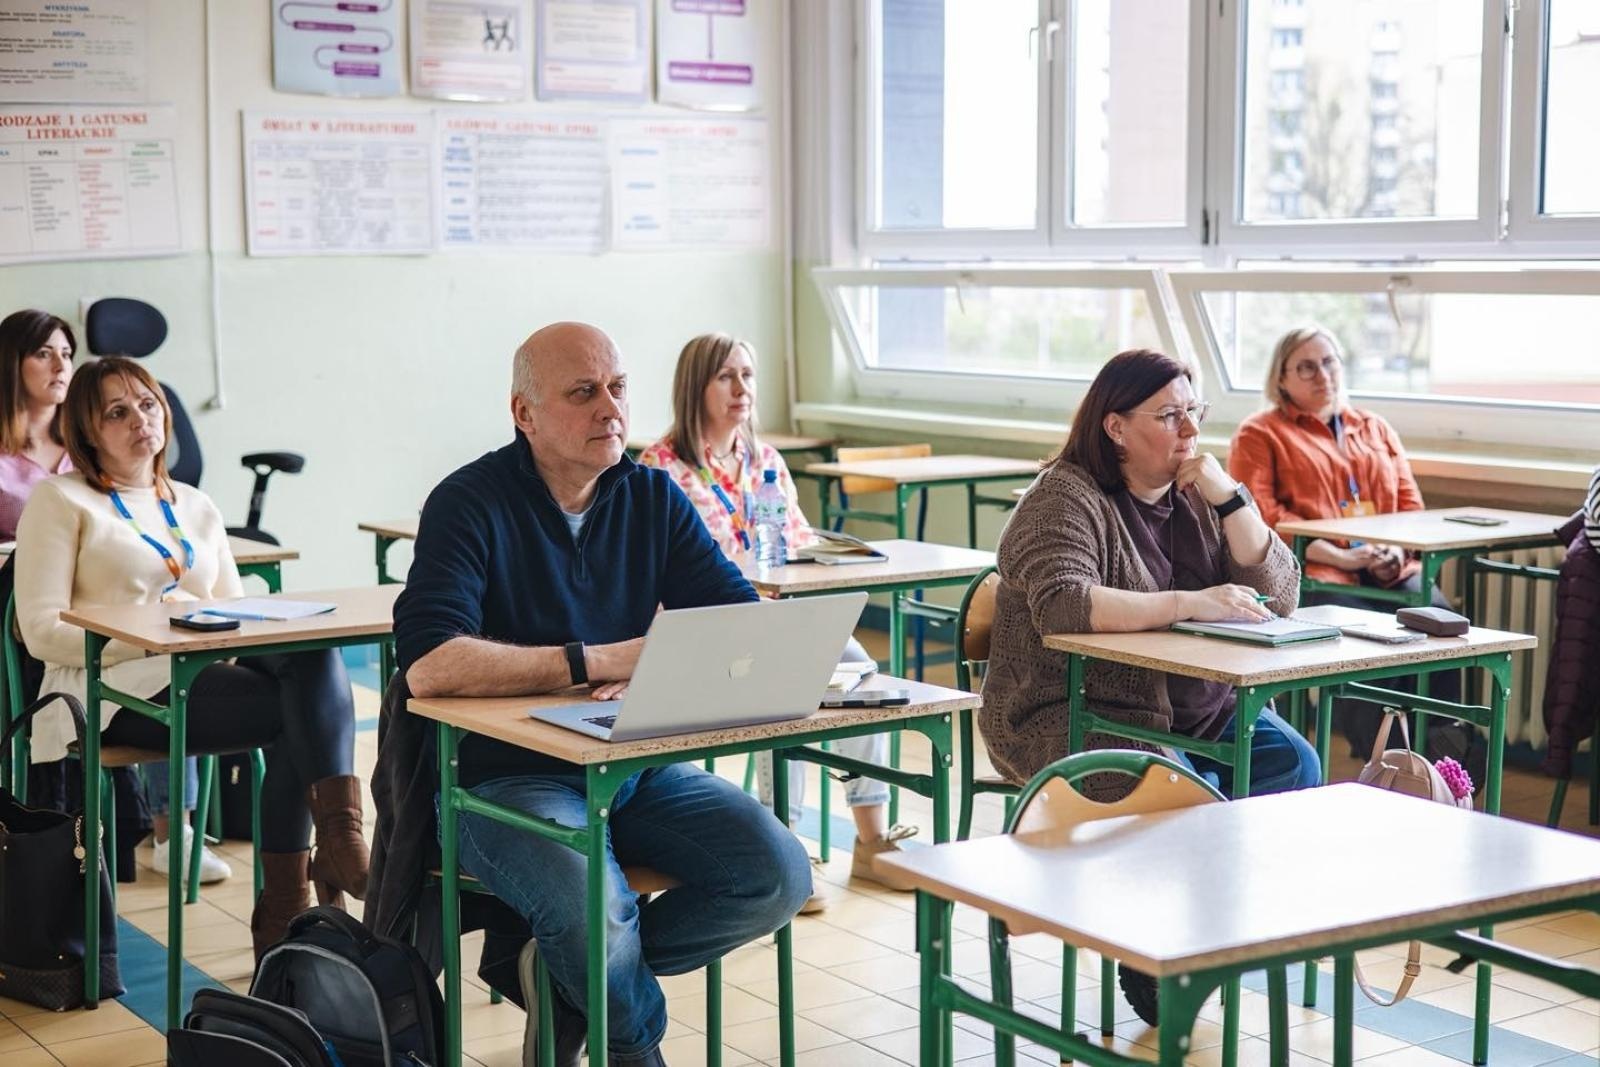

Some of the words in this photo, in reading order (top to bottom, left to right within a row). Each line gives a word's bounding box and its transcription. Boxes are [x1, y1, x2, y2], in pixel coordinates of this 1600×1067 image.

[69, 115, 75, 125] I
[82, 112, 148, 125] GATUNKI
[27, 128, 118, 140] LITERACKIE
